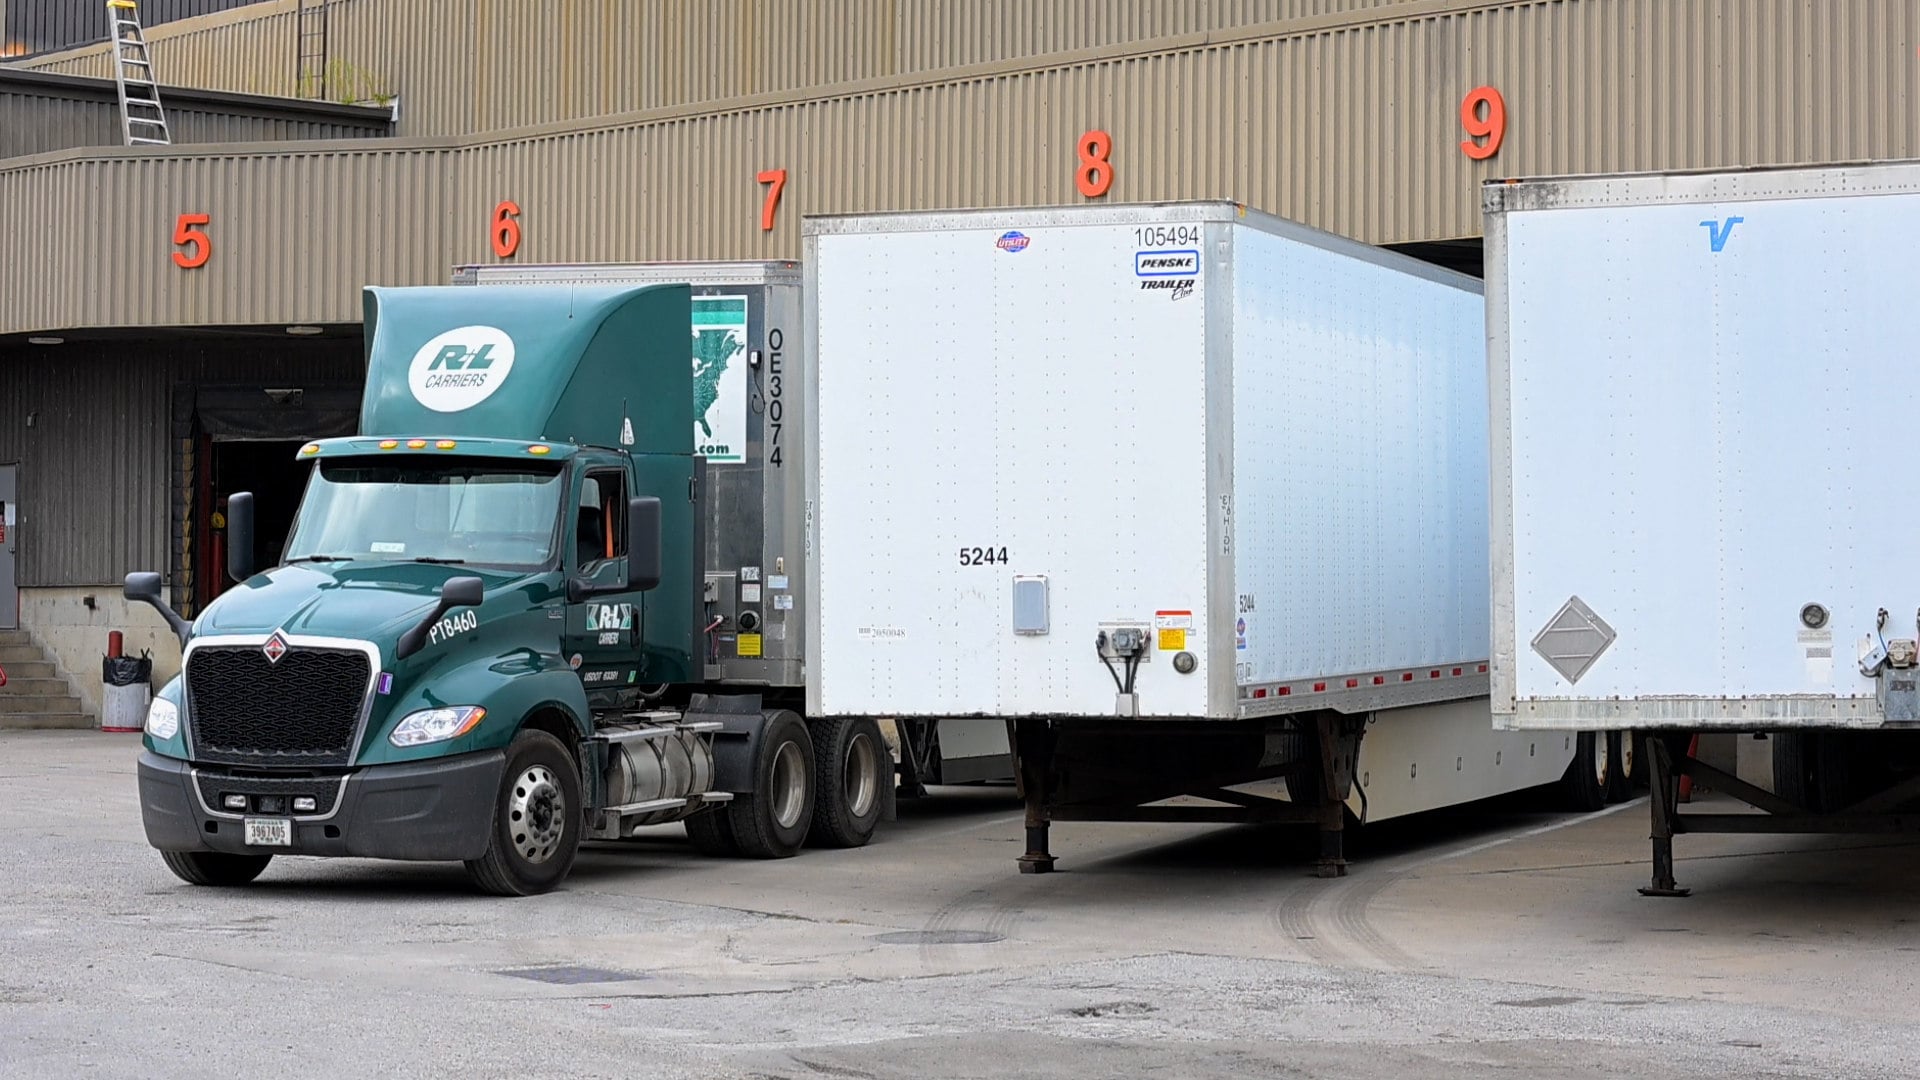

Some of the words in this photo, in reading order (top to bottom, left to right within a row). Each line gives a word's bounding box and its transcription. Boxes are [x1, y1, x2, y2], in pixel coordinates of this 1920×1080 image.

[1460, 86, 1506, 160] 9
[1075, 129, 1114, 198] 8
[757, 168, 787, 231] 7
[491, 200, 521, 258] 6
[1135, 226, 1199, 247] 105494
[172, 213, 211, 269] 5
[997, 237, 1030, 249] UTILITY
[1141, 257, 1194, 268] PENSKE
[1141, 279, 1194, 289] TRAILER
[428, 343, 496, 371] R+L
[425, 373, 488, 389] CARRIERS
[960, 547, 1009, 566] 5244
[1239, 595, 1255, 613] 5244
[429, 610, 477, 645] PT8460
[584, 671, 602, 681] USDOT
